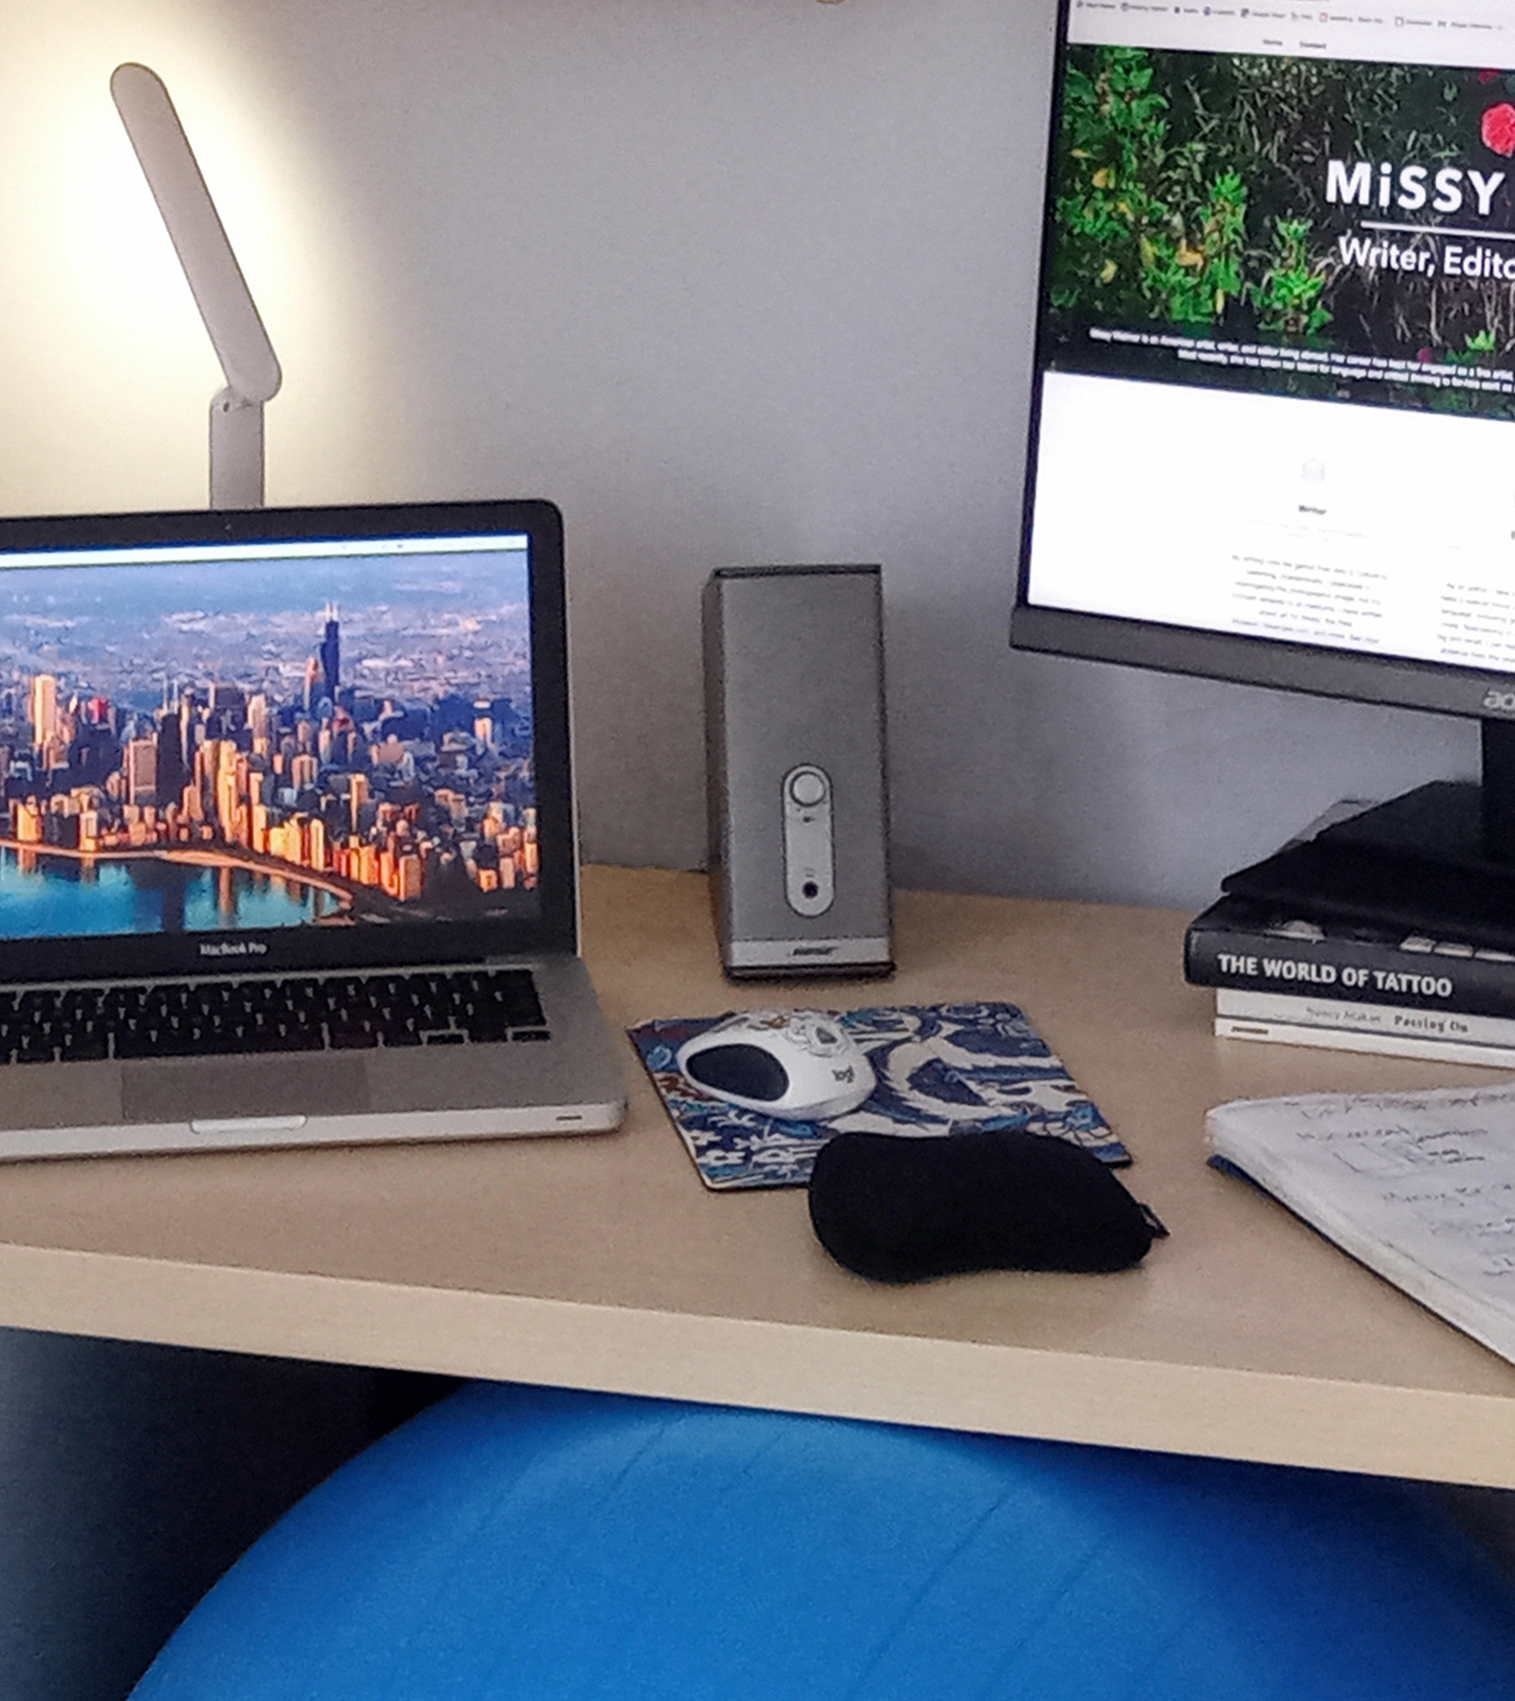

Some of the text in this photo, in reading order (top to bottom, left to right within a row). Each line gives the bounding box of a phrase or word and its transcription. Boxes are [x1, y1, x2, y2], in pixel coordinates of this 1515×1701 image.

[1324, 159, 1505, 217] MiSSY
[1338, 234, 1436, 278] Writer,
[248, 941, 268, 956] Pro
[1216, 953, 1453, 998] THE WORLD OF TATTOO
